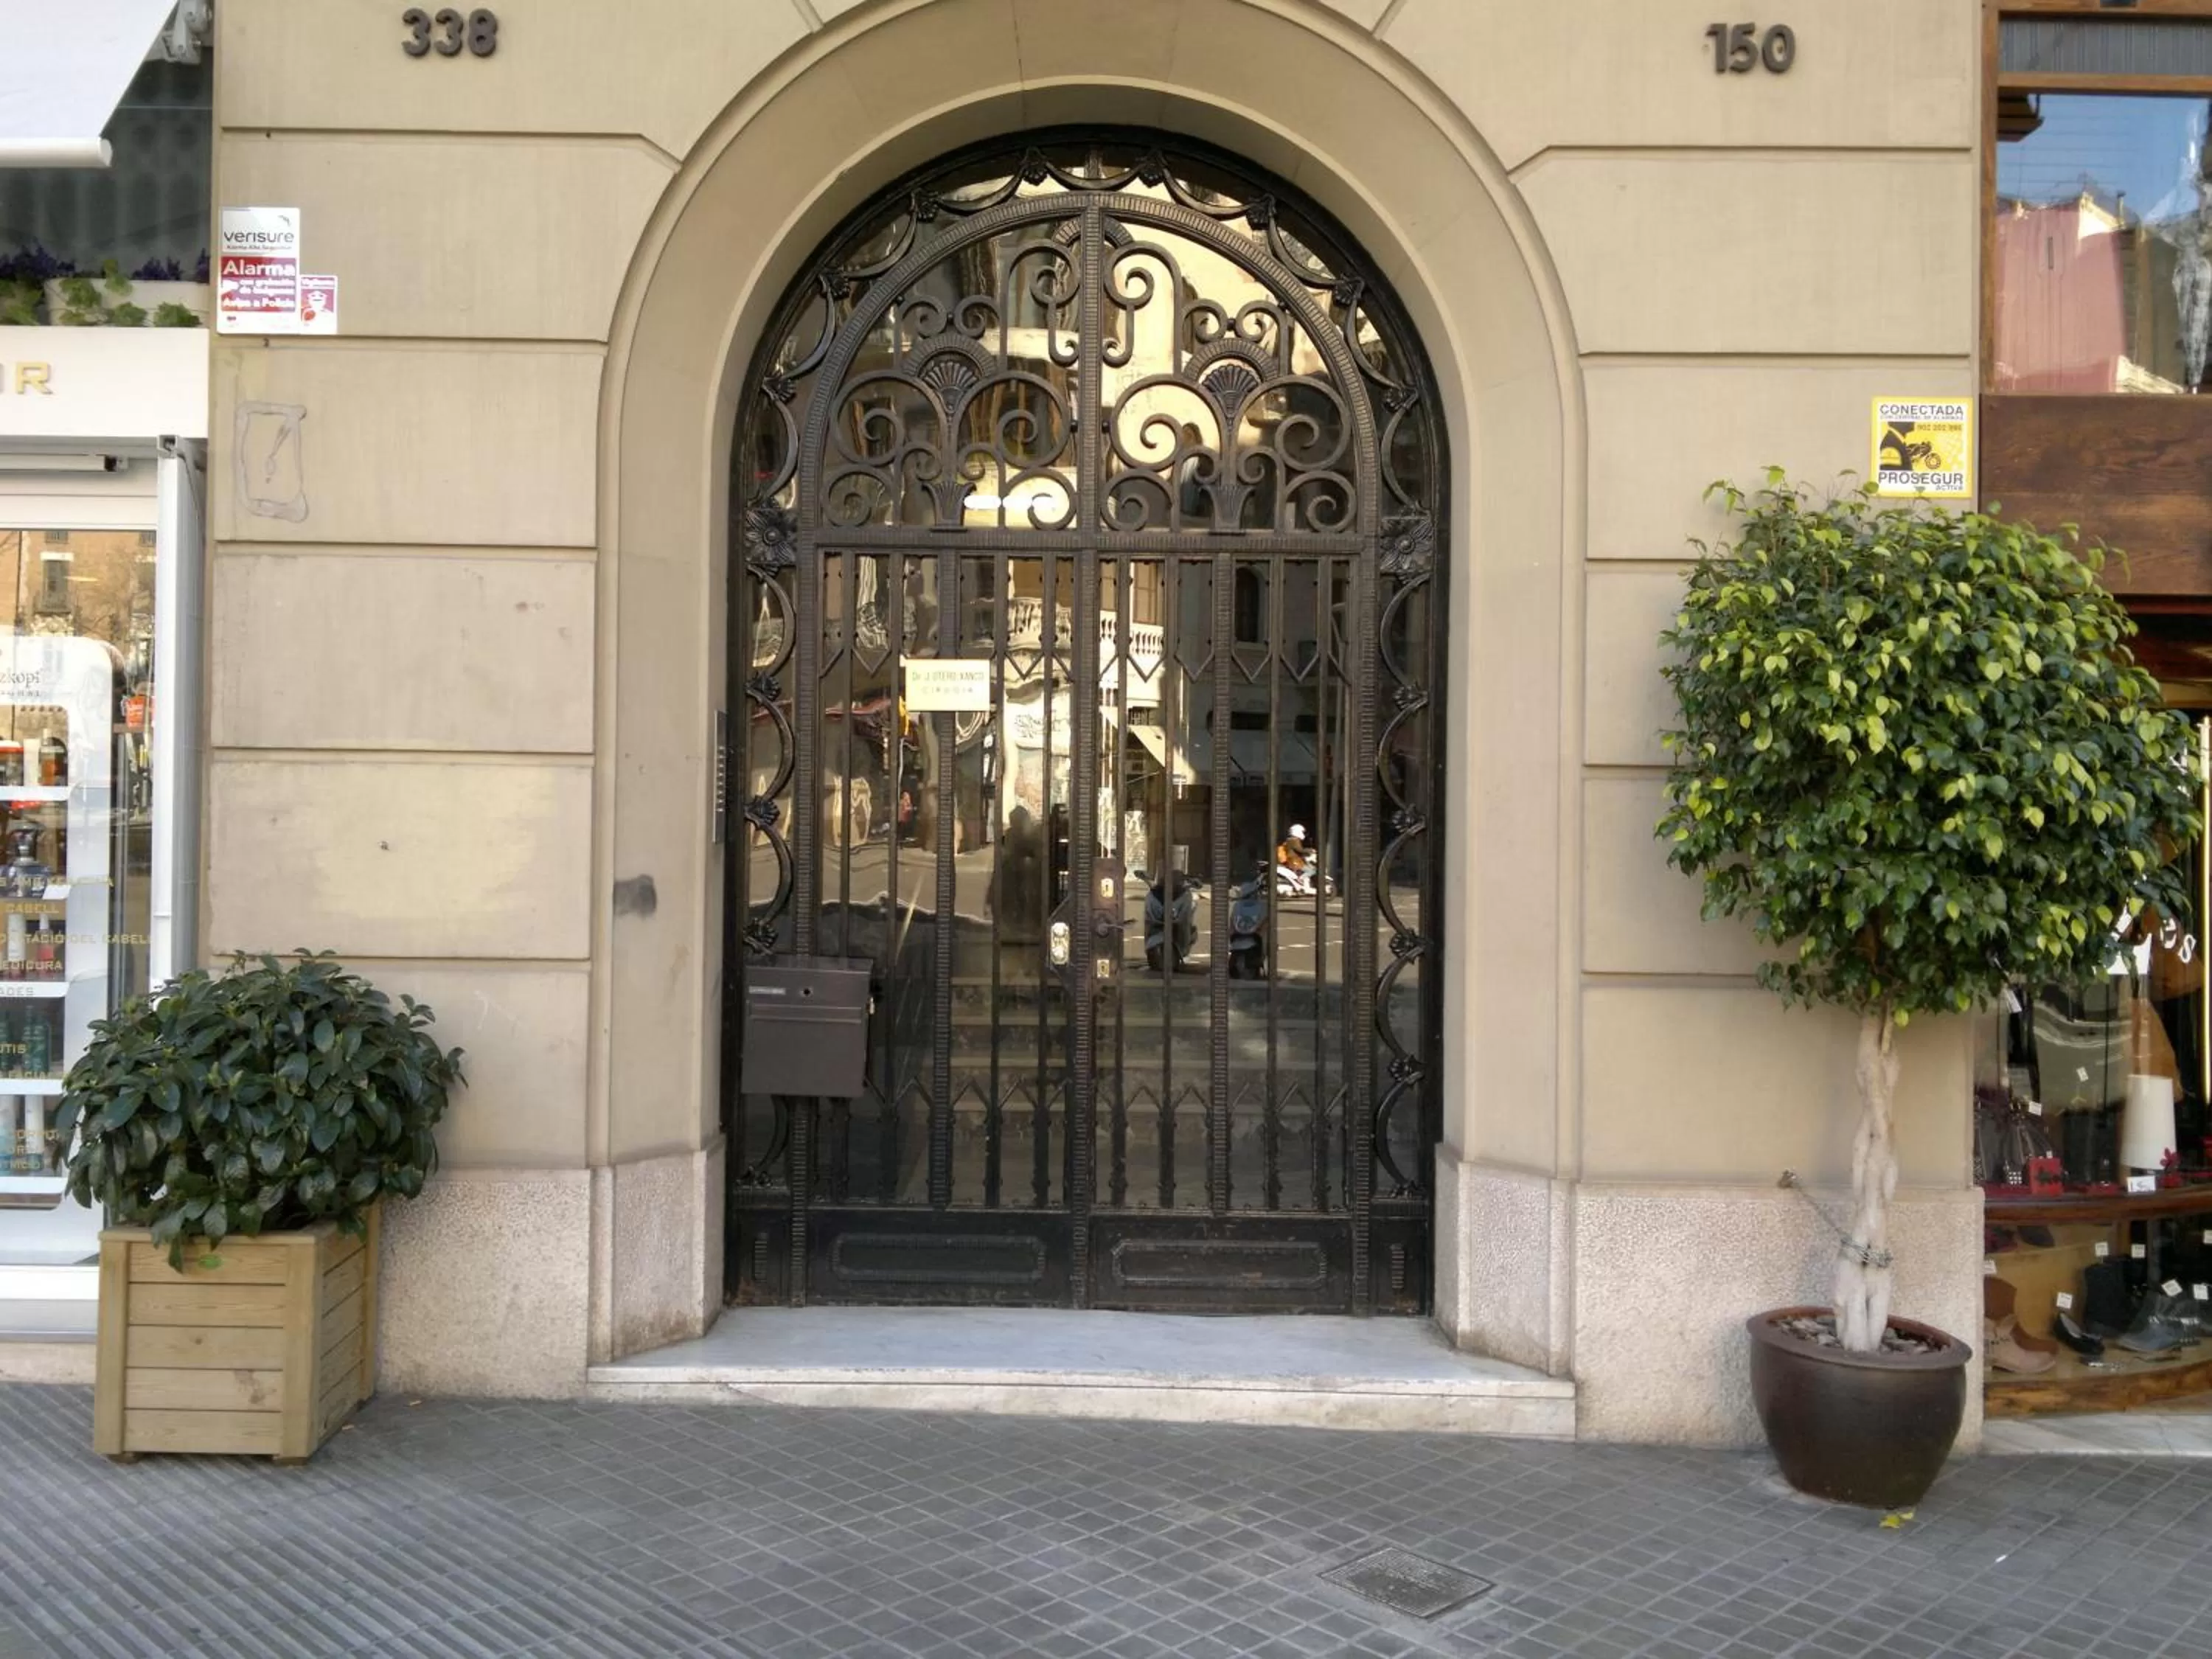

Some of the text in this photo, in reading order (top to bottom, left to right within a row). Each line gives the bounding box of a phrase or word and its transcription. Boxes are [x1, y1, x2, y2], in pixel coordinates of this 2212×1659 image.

[402, 8, 498, 58] 338
[1705, 22, 1796, 74] 150
[223, 232, 294, 243] verisure
[223, 260, 295, 275] Alarma
[1879, 405, 1964, 415] CONECTADA
[1878, 472, 1964, 484] PROSEGUR
